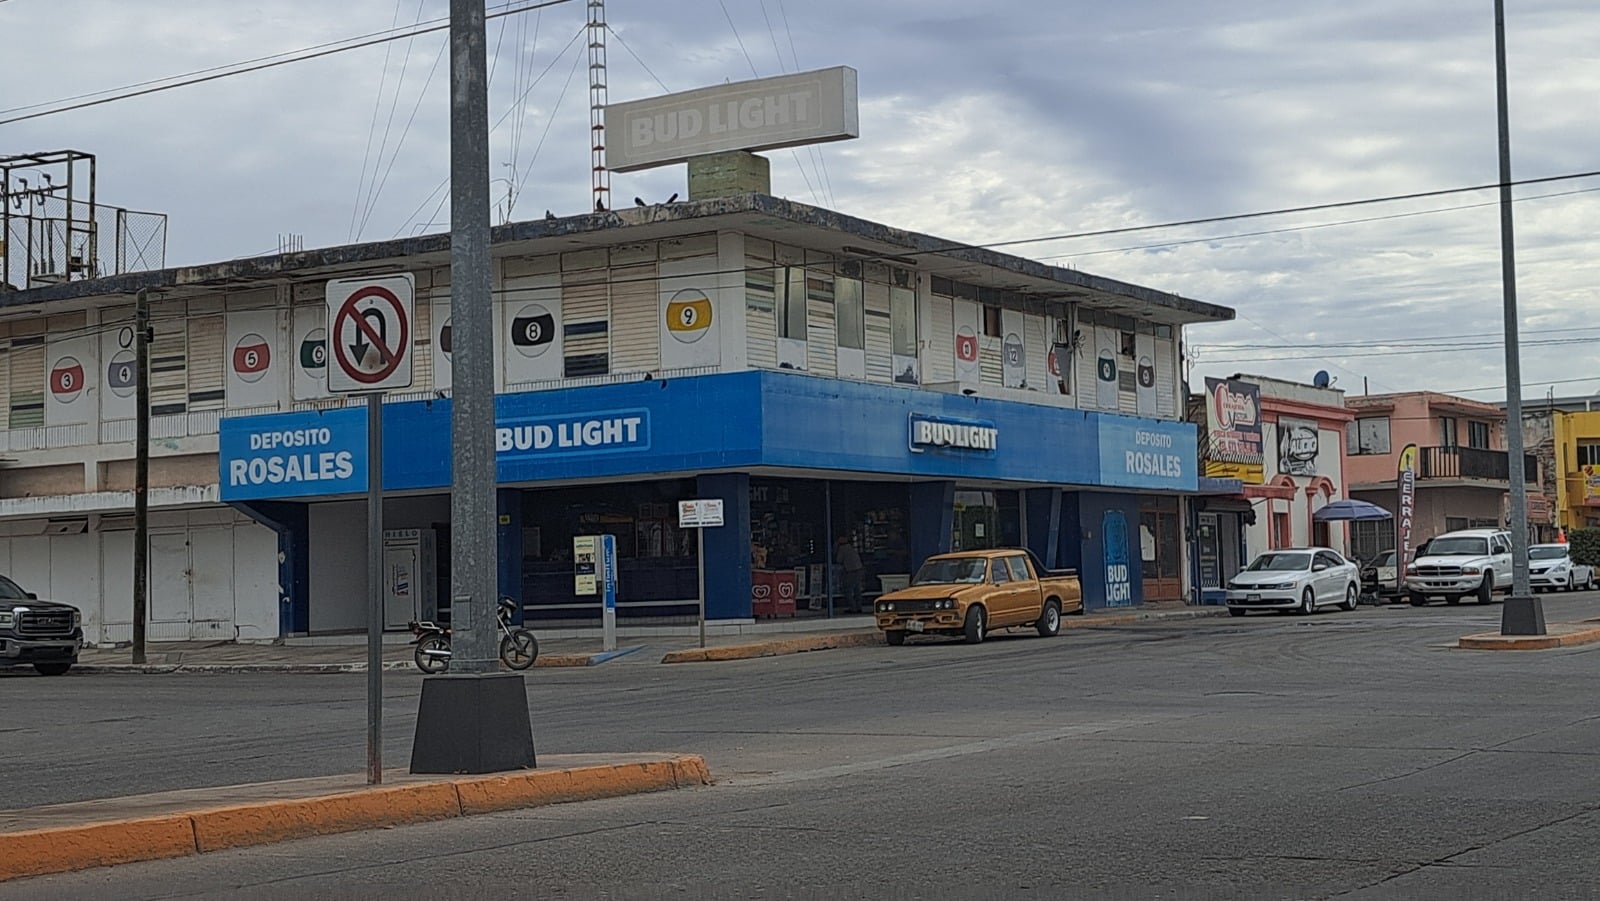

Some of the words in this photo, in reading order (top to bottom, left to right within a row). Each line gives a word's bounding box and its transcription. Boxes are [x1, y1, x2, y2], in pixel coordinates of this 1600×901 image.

[631, 109, 702, 147] BUD
[709, 91, 812, 134] LIGHT
[684, 308, 693, 325] 9
[529, 323, 538, 339] 8
[248, 352, 256, 366] 5
[315, 347, 323, 361] 6
[63, 374, 71, 387] 3
[121, 368, 128, 380] 4
[250, 428, 331, 450] DEPOSITO
[496, 425, 553, 452] BUD
[558, 417, 641, 447] LIGHT
[915, 420, 955, 445] BUD
[956, 424, 998, 449] LIGHT
[1135, 430, 1172, 448] DEPOSITO
[230, 451, 354, 487] ROSALES
[1125, 450, 1181, 478] ROSALES
[385, 530, 418, 539] HIELO
[1107, 564, 1128, 583] BUD
[1105, 582, 1131, 602] LIGHT
